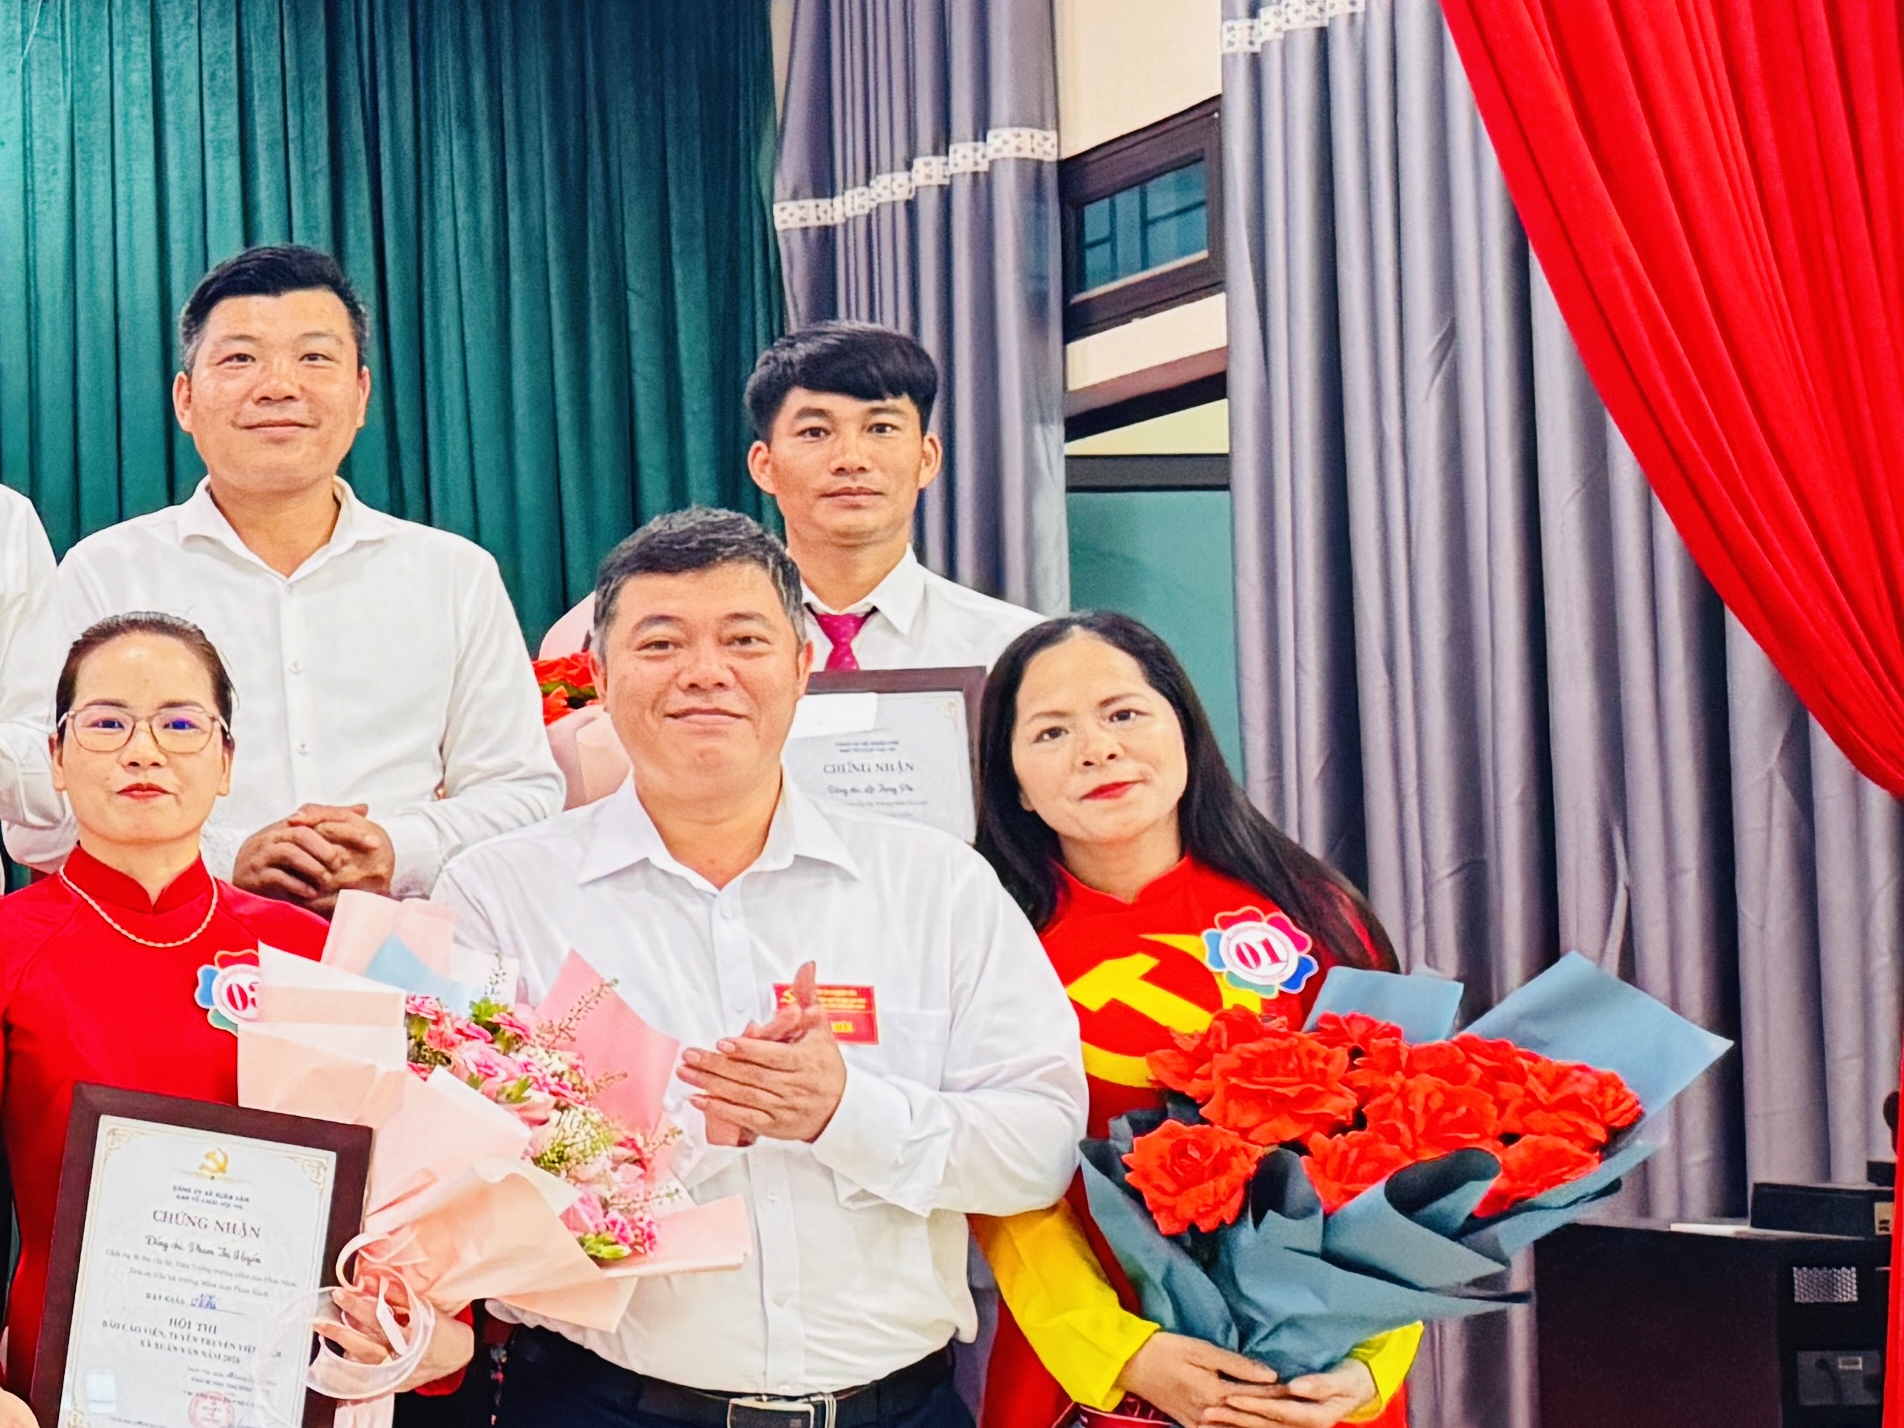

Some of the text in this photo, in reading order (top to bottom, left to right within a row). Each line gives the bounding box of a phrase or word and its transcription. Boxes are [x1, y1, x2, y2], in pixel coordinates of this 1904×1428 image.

[1235, 938, 1289, 970] 01
[152, 1209, 262, 1239] CHỨNG NHẬN
[168, 1316, 218, 1335] HỘI THI
